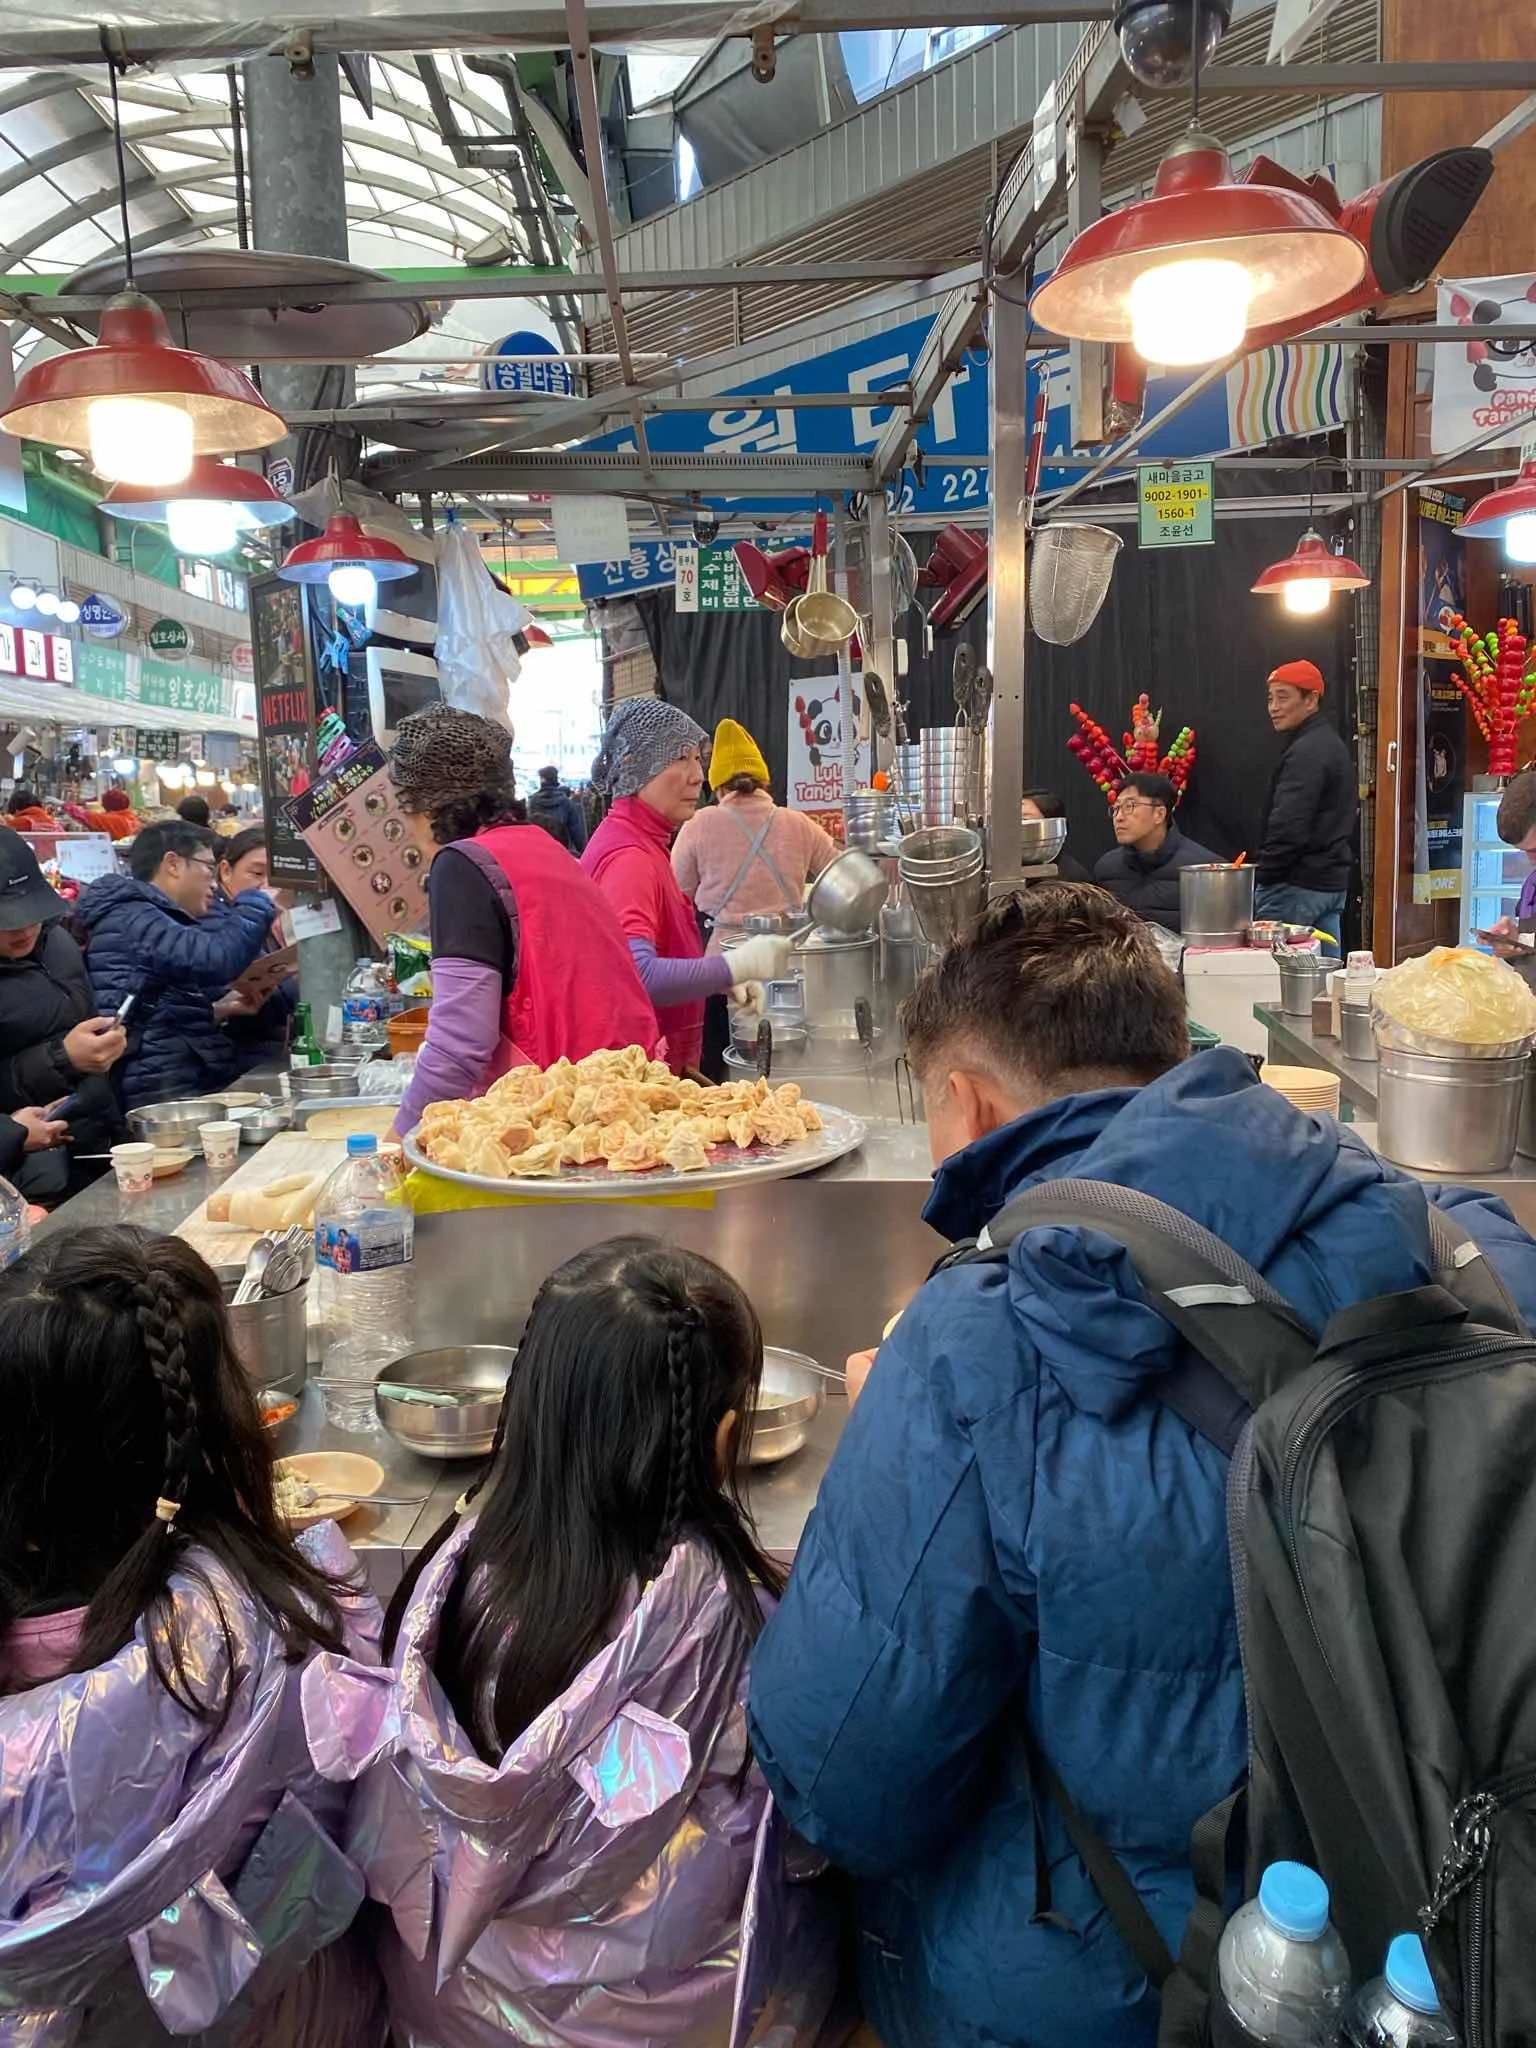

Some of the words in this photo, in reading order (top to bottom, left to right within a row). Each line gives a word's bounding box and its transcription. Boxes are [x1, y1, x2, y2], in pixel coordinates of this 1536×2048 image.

[1147, 469, 1205, 484] 새마을금고
[1145, 488, 1208, 502] 9002-1901-
[1158, 507, 1195, 519] 1560-1
[1160, 524, 1193, 537] 조윤선
[603, 541, 692, 586] 진흥상
[681, 570, 694, 584] 70
[702, 563, 720, 608] 수제비
[682, 587, 692, 602] 호
[168, 674, 219, 714] 일호상사
[262, 689, 308, 727] NETFLIX
[814, 764, 844, 782] LuL
[796, 780, 870, 801] Tangh
